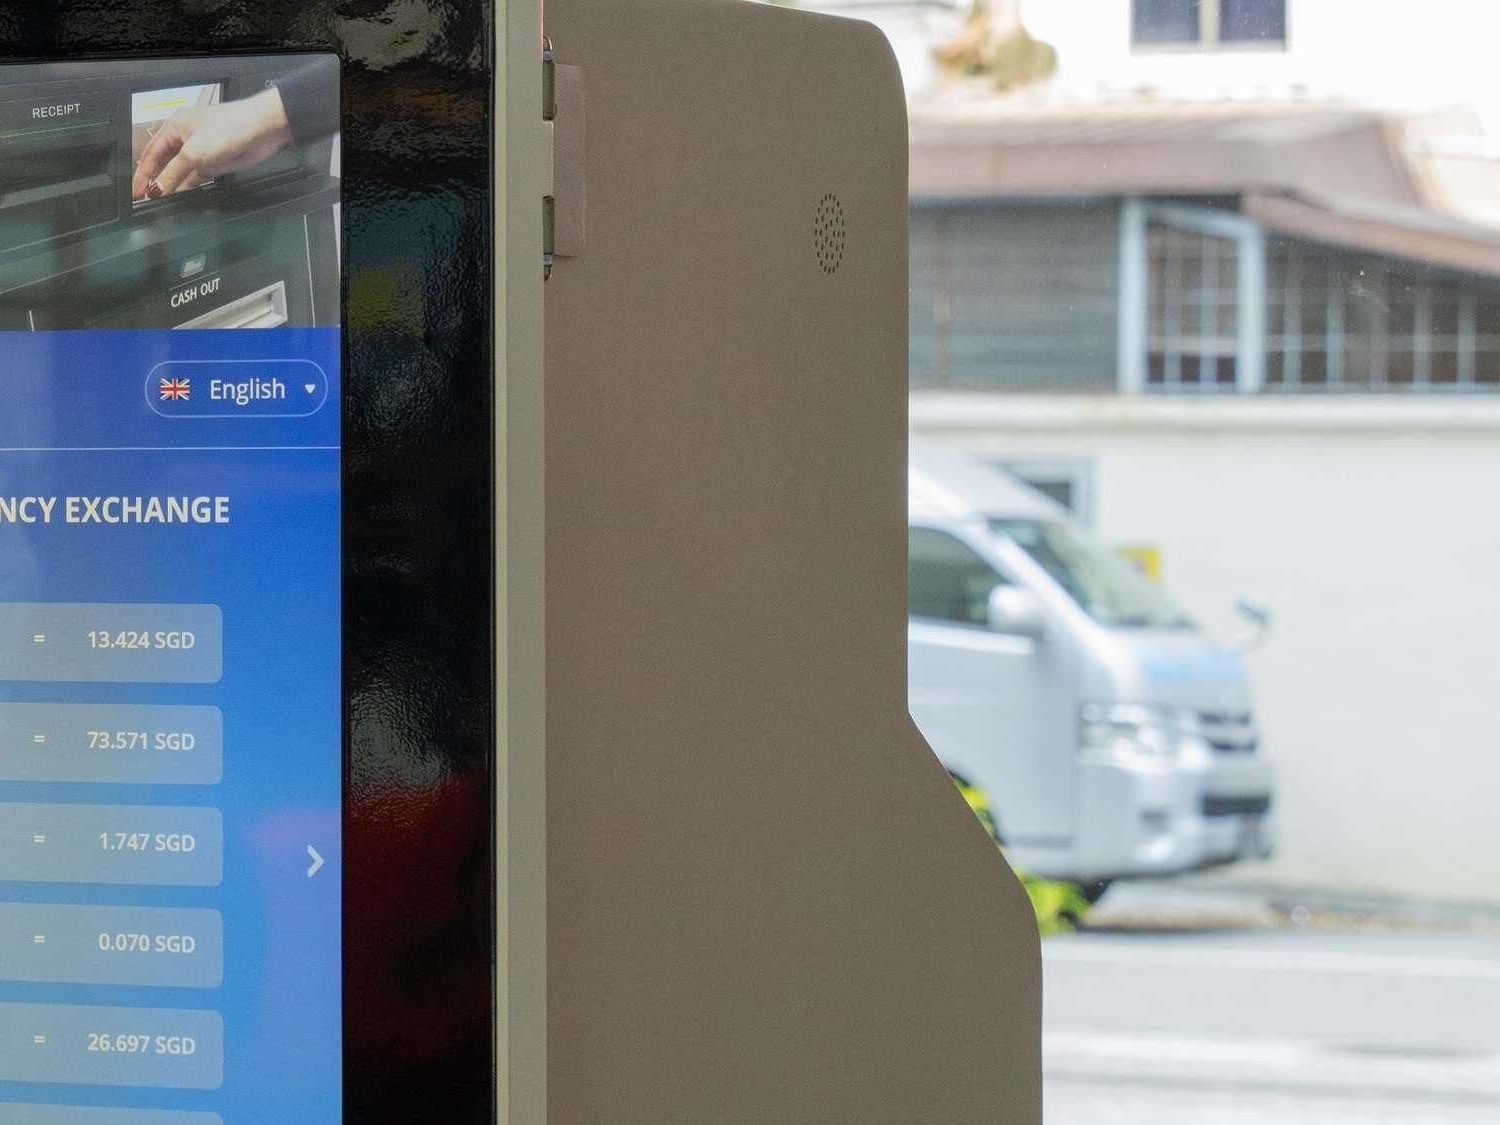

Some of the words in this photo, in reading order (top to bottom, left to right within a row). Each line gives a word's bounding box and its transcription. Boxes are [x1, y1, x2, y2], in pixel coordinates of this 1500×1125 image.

[32, 103, 81, 118] RECEIPT
[170, 288, 198, 308] CASH
[199, 277, 221, 297] OUT
[210, 377, 285, 406] English
[65, 496, 229, 523] EXCHANGE
[88, 630, 150, 649] 13.424
[154, 631, 195, 649] SGD
[87, 731, 148, 750] 73.571
[155, 732, 195, 751] SGD
[99, 832, 150, 851] 1.747
[155, 833, 196, 852] SGD
[99, 933, 150, 952] 0.070
[155, 935, 196, 953] SGD
[88, 1033, 150, 1052] 26.697
[155, 1036, 196, 1055] SGD
